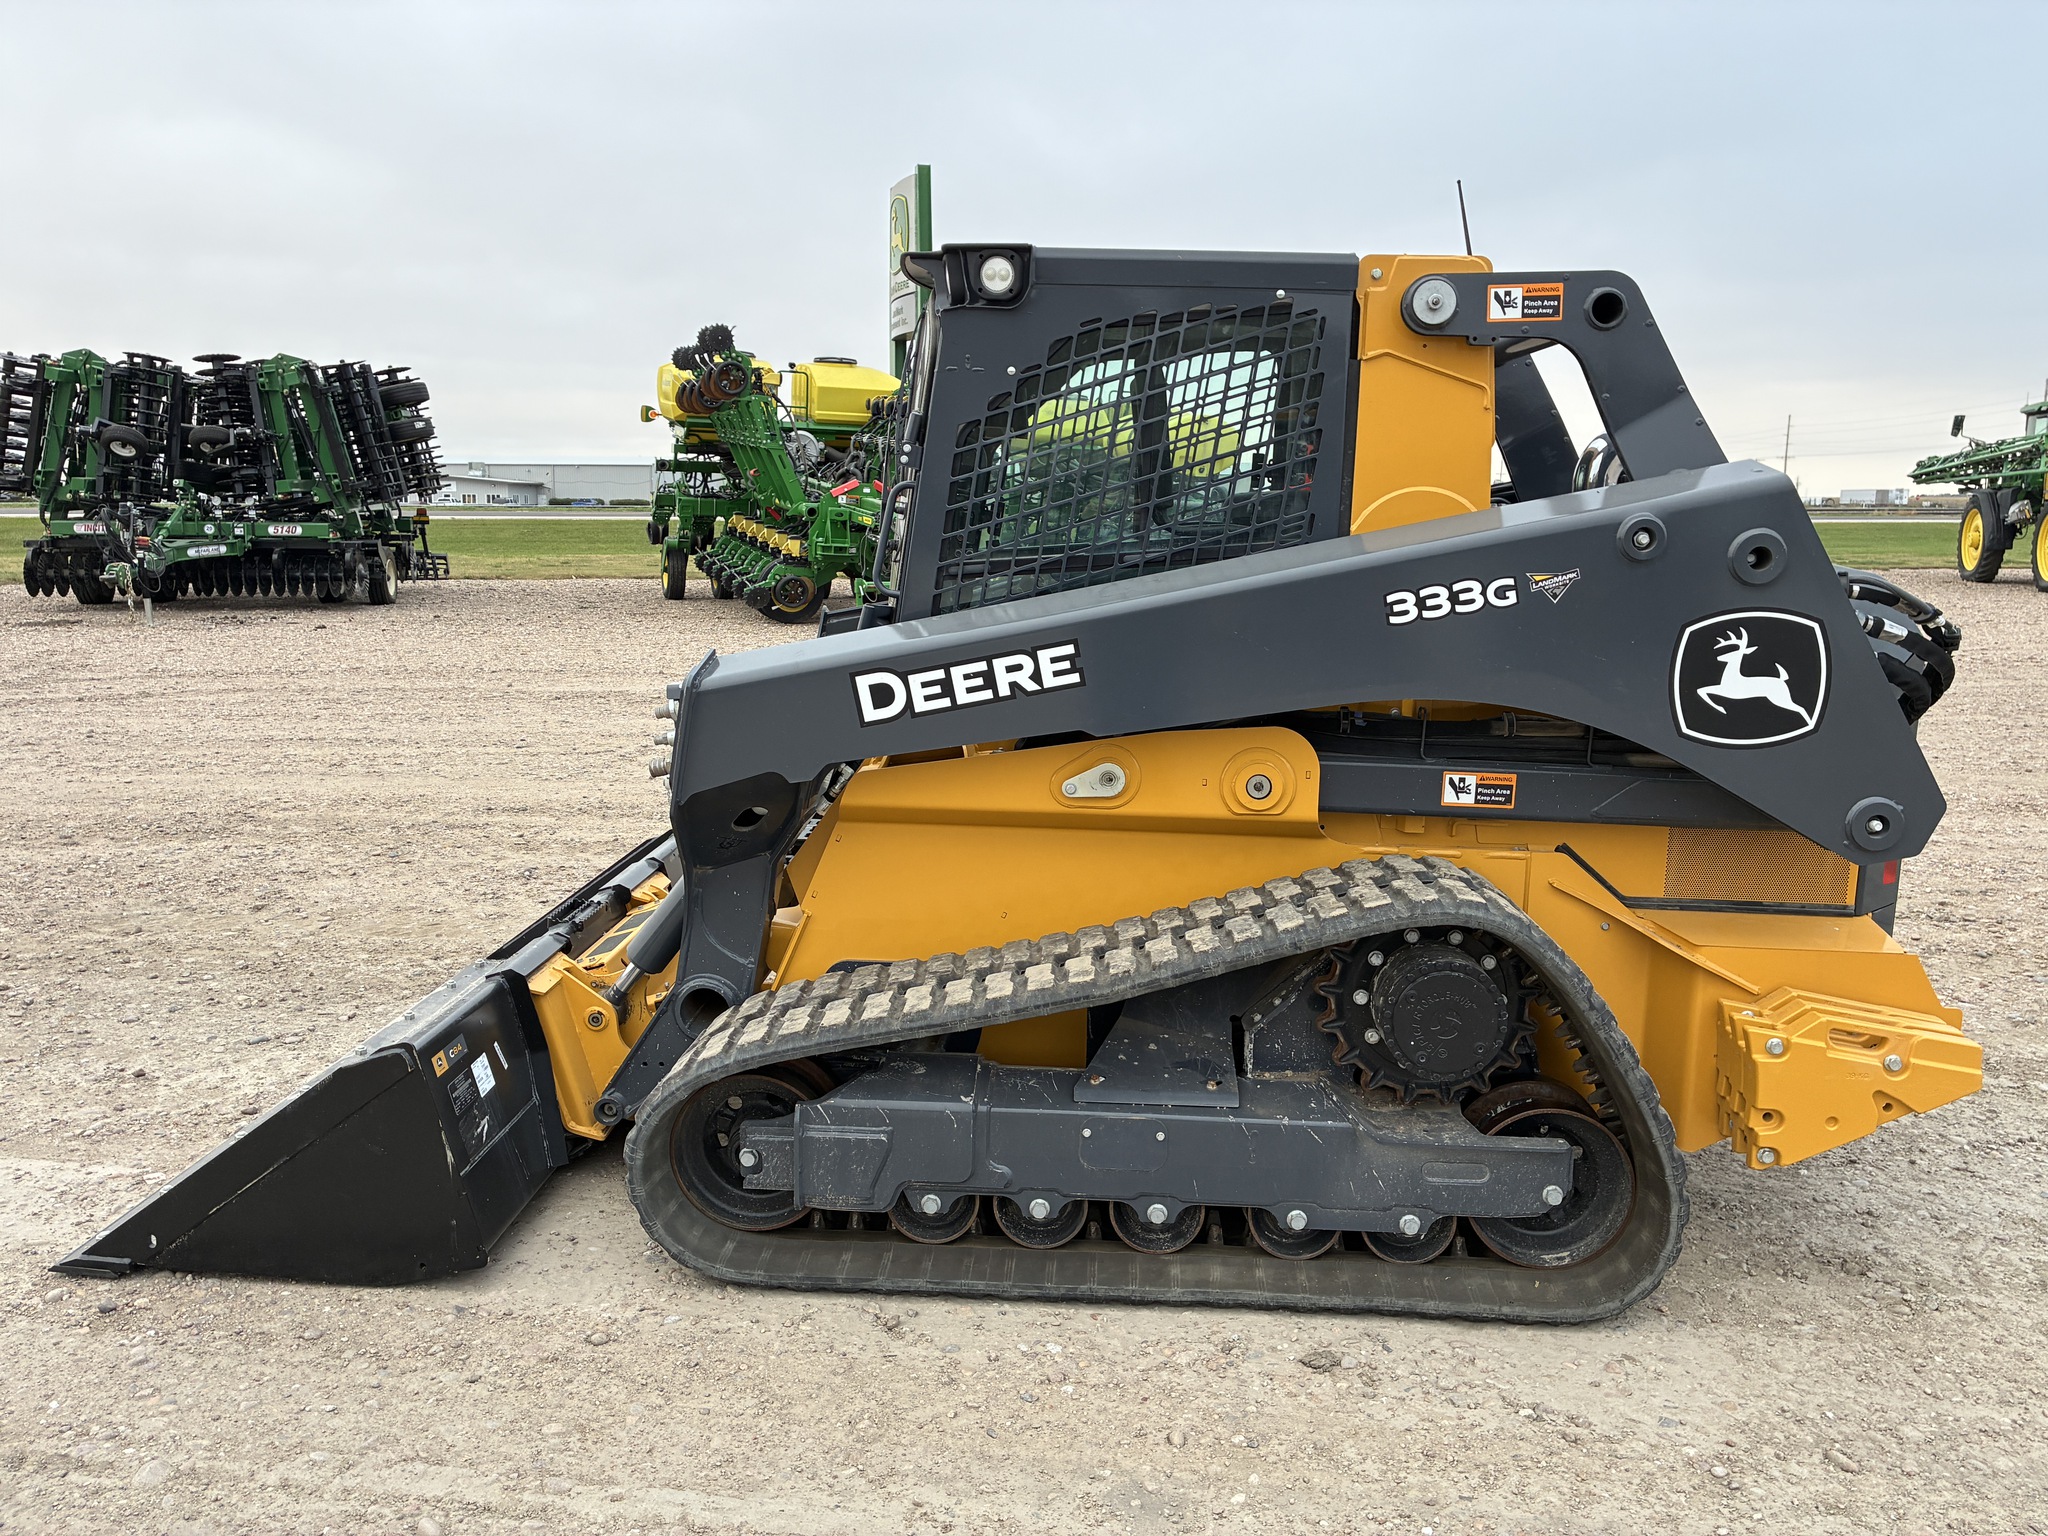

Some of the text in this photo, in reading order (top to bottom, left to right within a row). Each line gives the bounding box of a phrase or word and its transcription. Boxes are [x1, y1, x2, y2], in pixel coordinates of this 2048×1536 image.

[1524, 299, 1542, 307] Pinch
[272, 524, 298, 535] 5140
[1532, 571, 1578, 589] LANDMARK
[1385, 577, 1519, 625] 333G
[853, 642, 1083, 724] DEERE
[1485, 775, 1513, 783] WARNING
[1477, 787, 1495, 795] Pinch
[448, 1042, 463, 1058] C84
